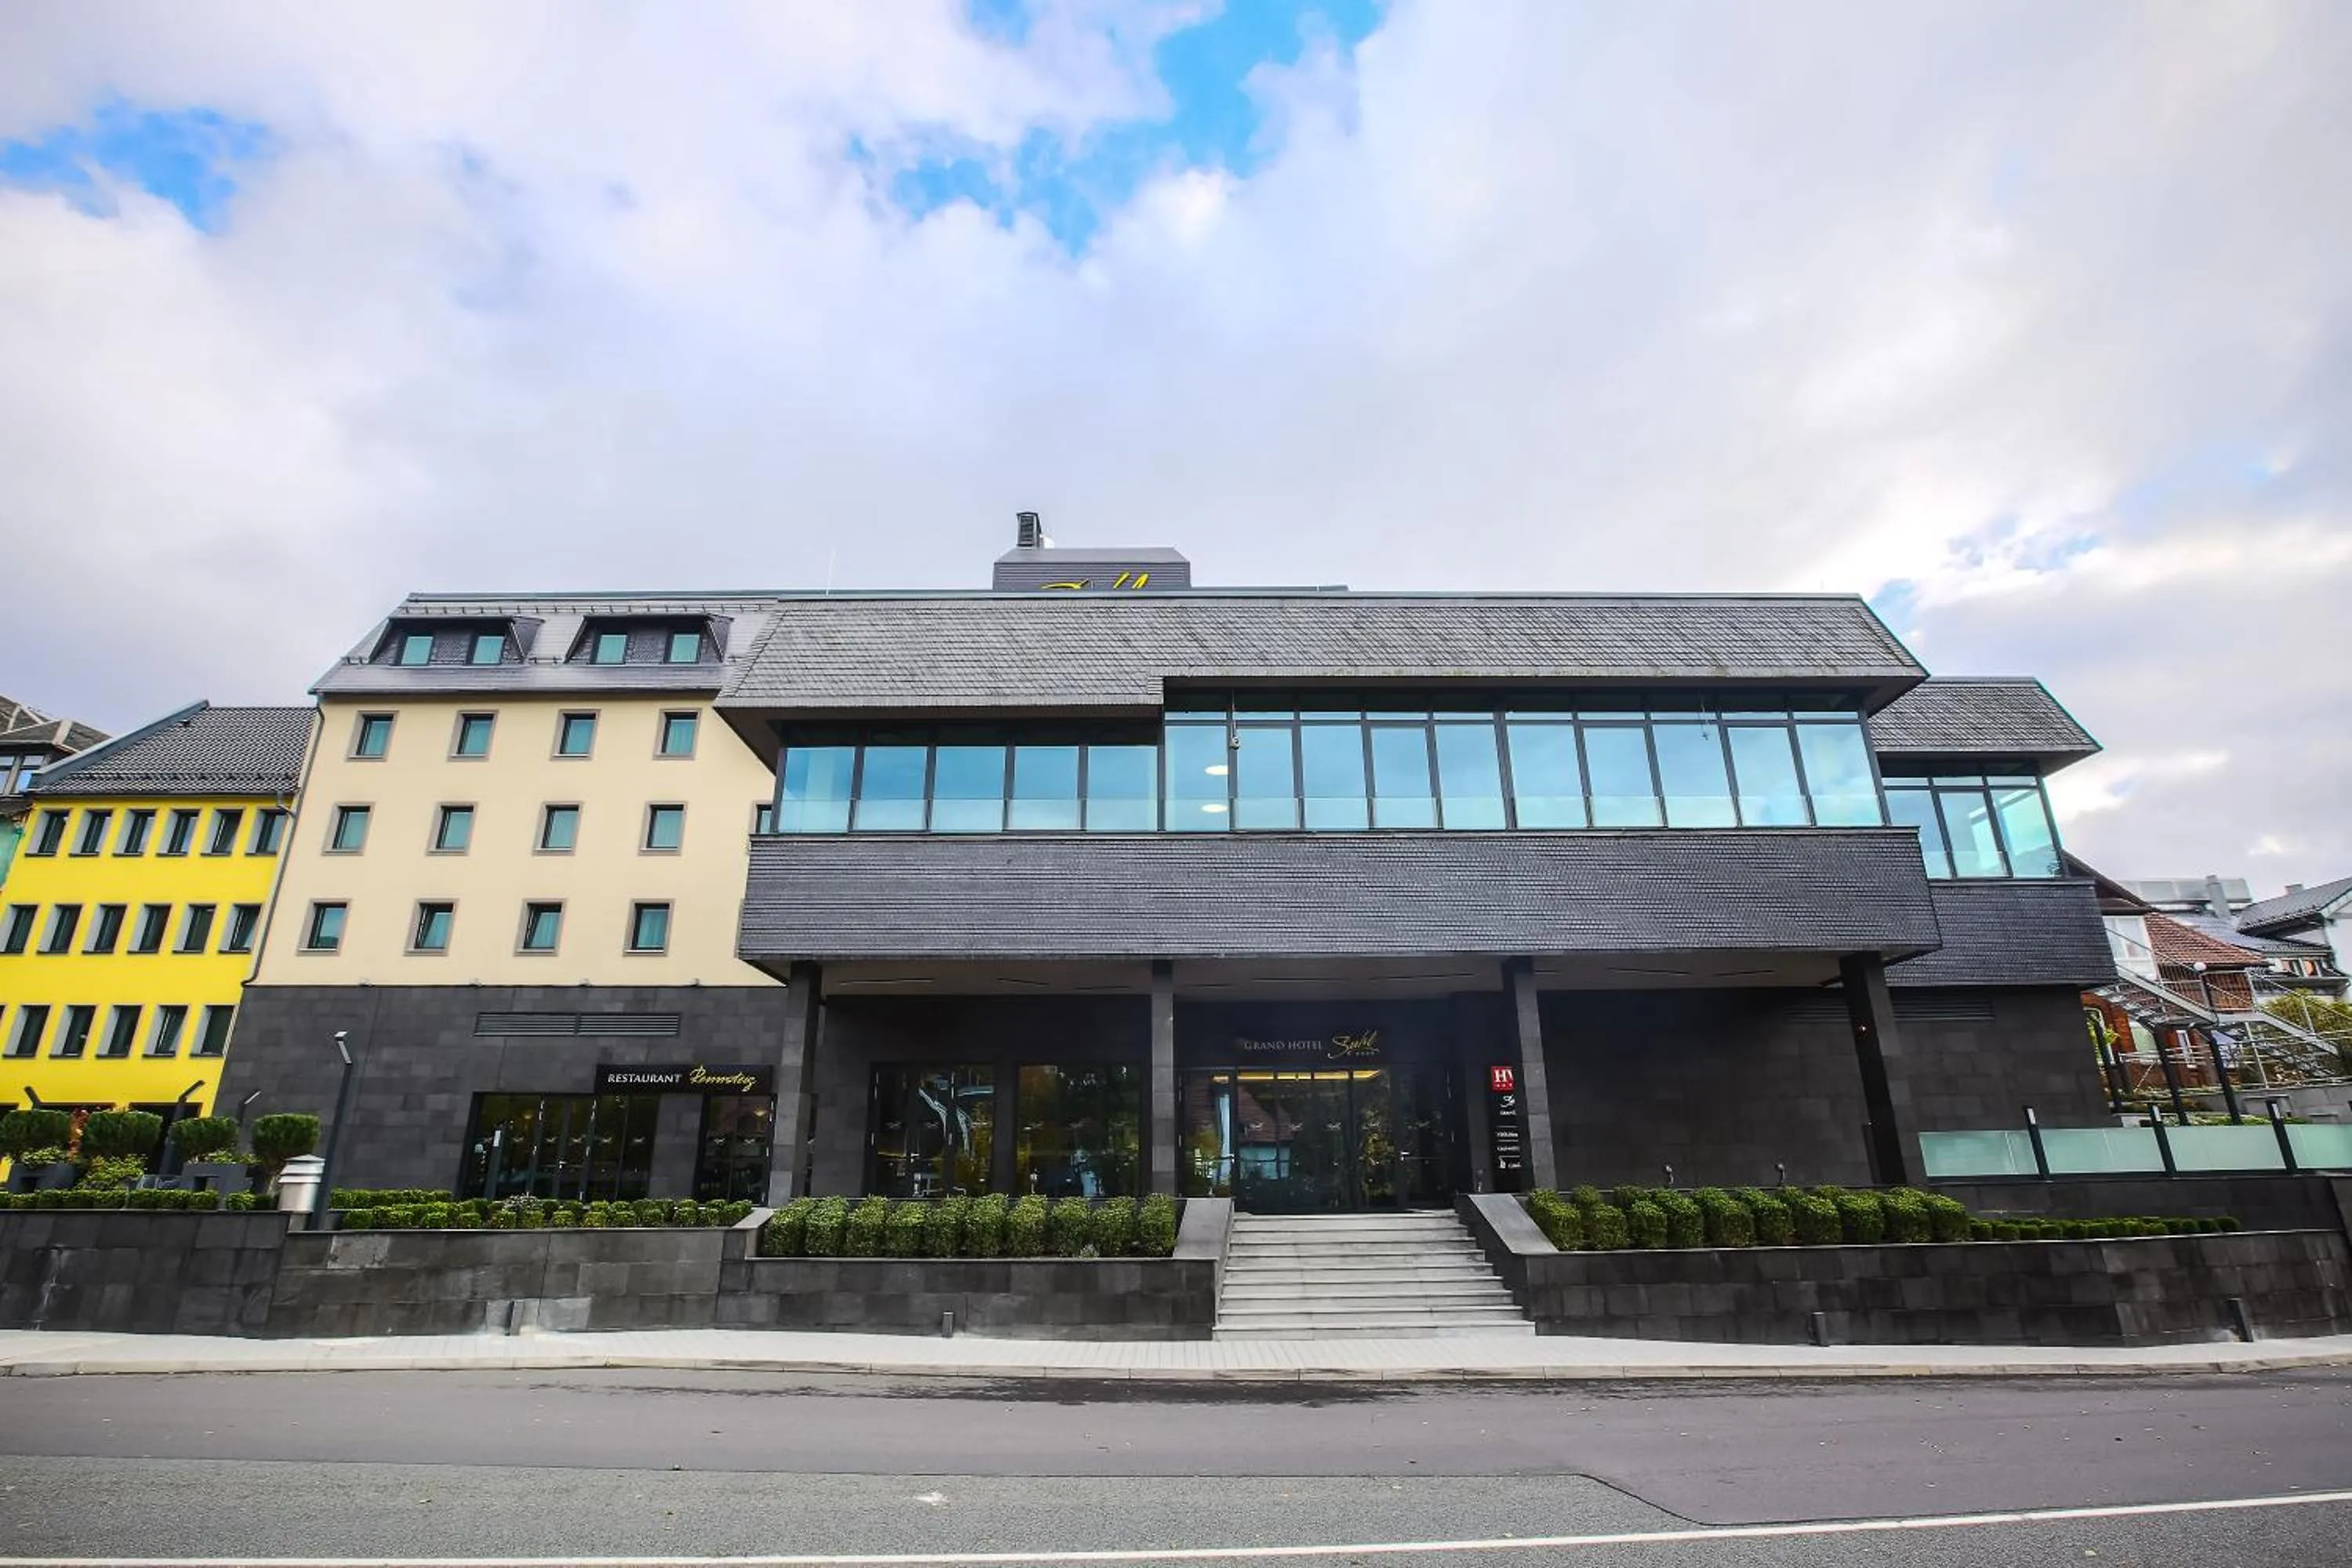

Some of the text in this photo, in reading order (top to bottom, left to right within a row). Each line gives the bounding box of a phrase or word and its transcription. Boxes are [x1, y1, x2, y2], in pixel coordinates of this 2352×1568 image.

[1243, 1029, 1380, 1059] GRAND HOTEL Suhl
[608, 1073, 683, 1084] RESTAURANT
